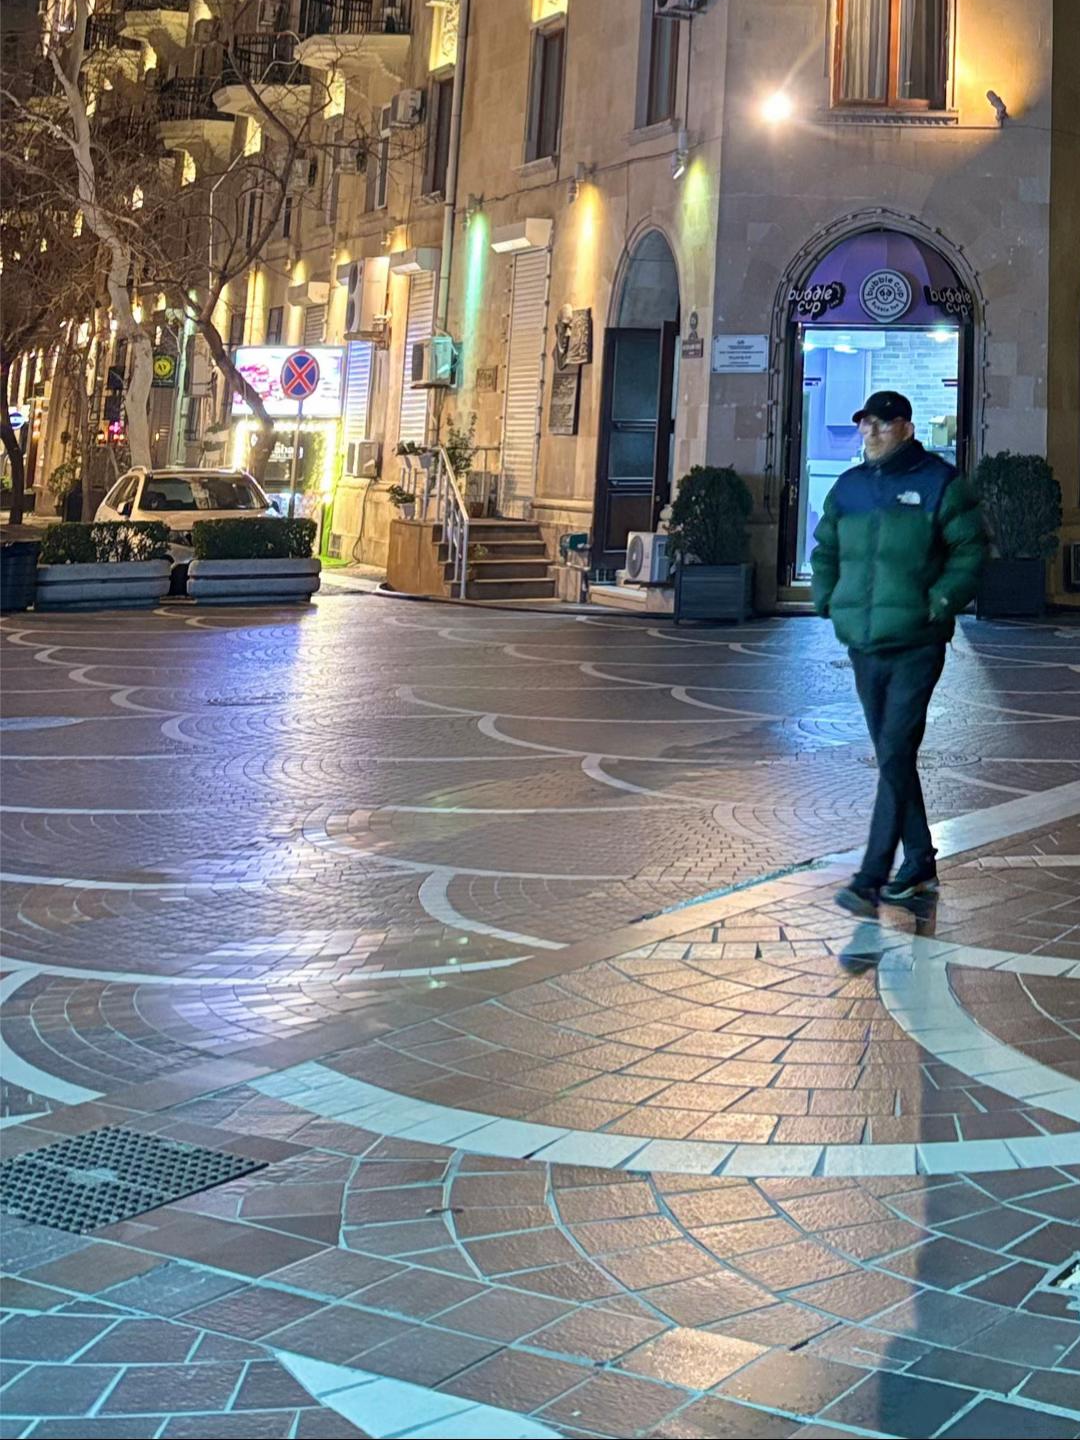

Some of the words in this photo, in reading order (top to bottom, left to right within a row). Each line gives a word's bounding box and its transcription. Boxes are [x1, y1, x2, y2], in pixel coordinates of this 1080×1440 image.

[866, 275, 893, 296] bubble
[894, 281, 904, 298] cup
[797, 300, 821, 316] cup
[946, 302, 969, 318] cup
